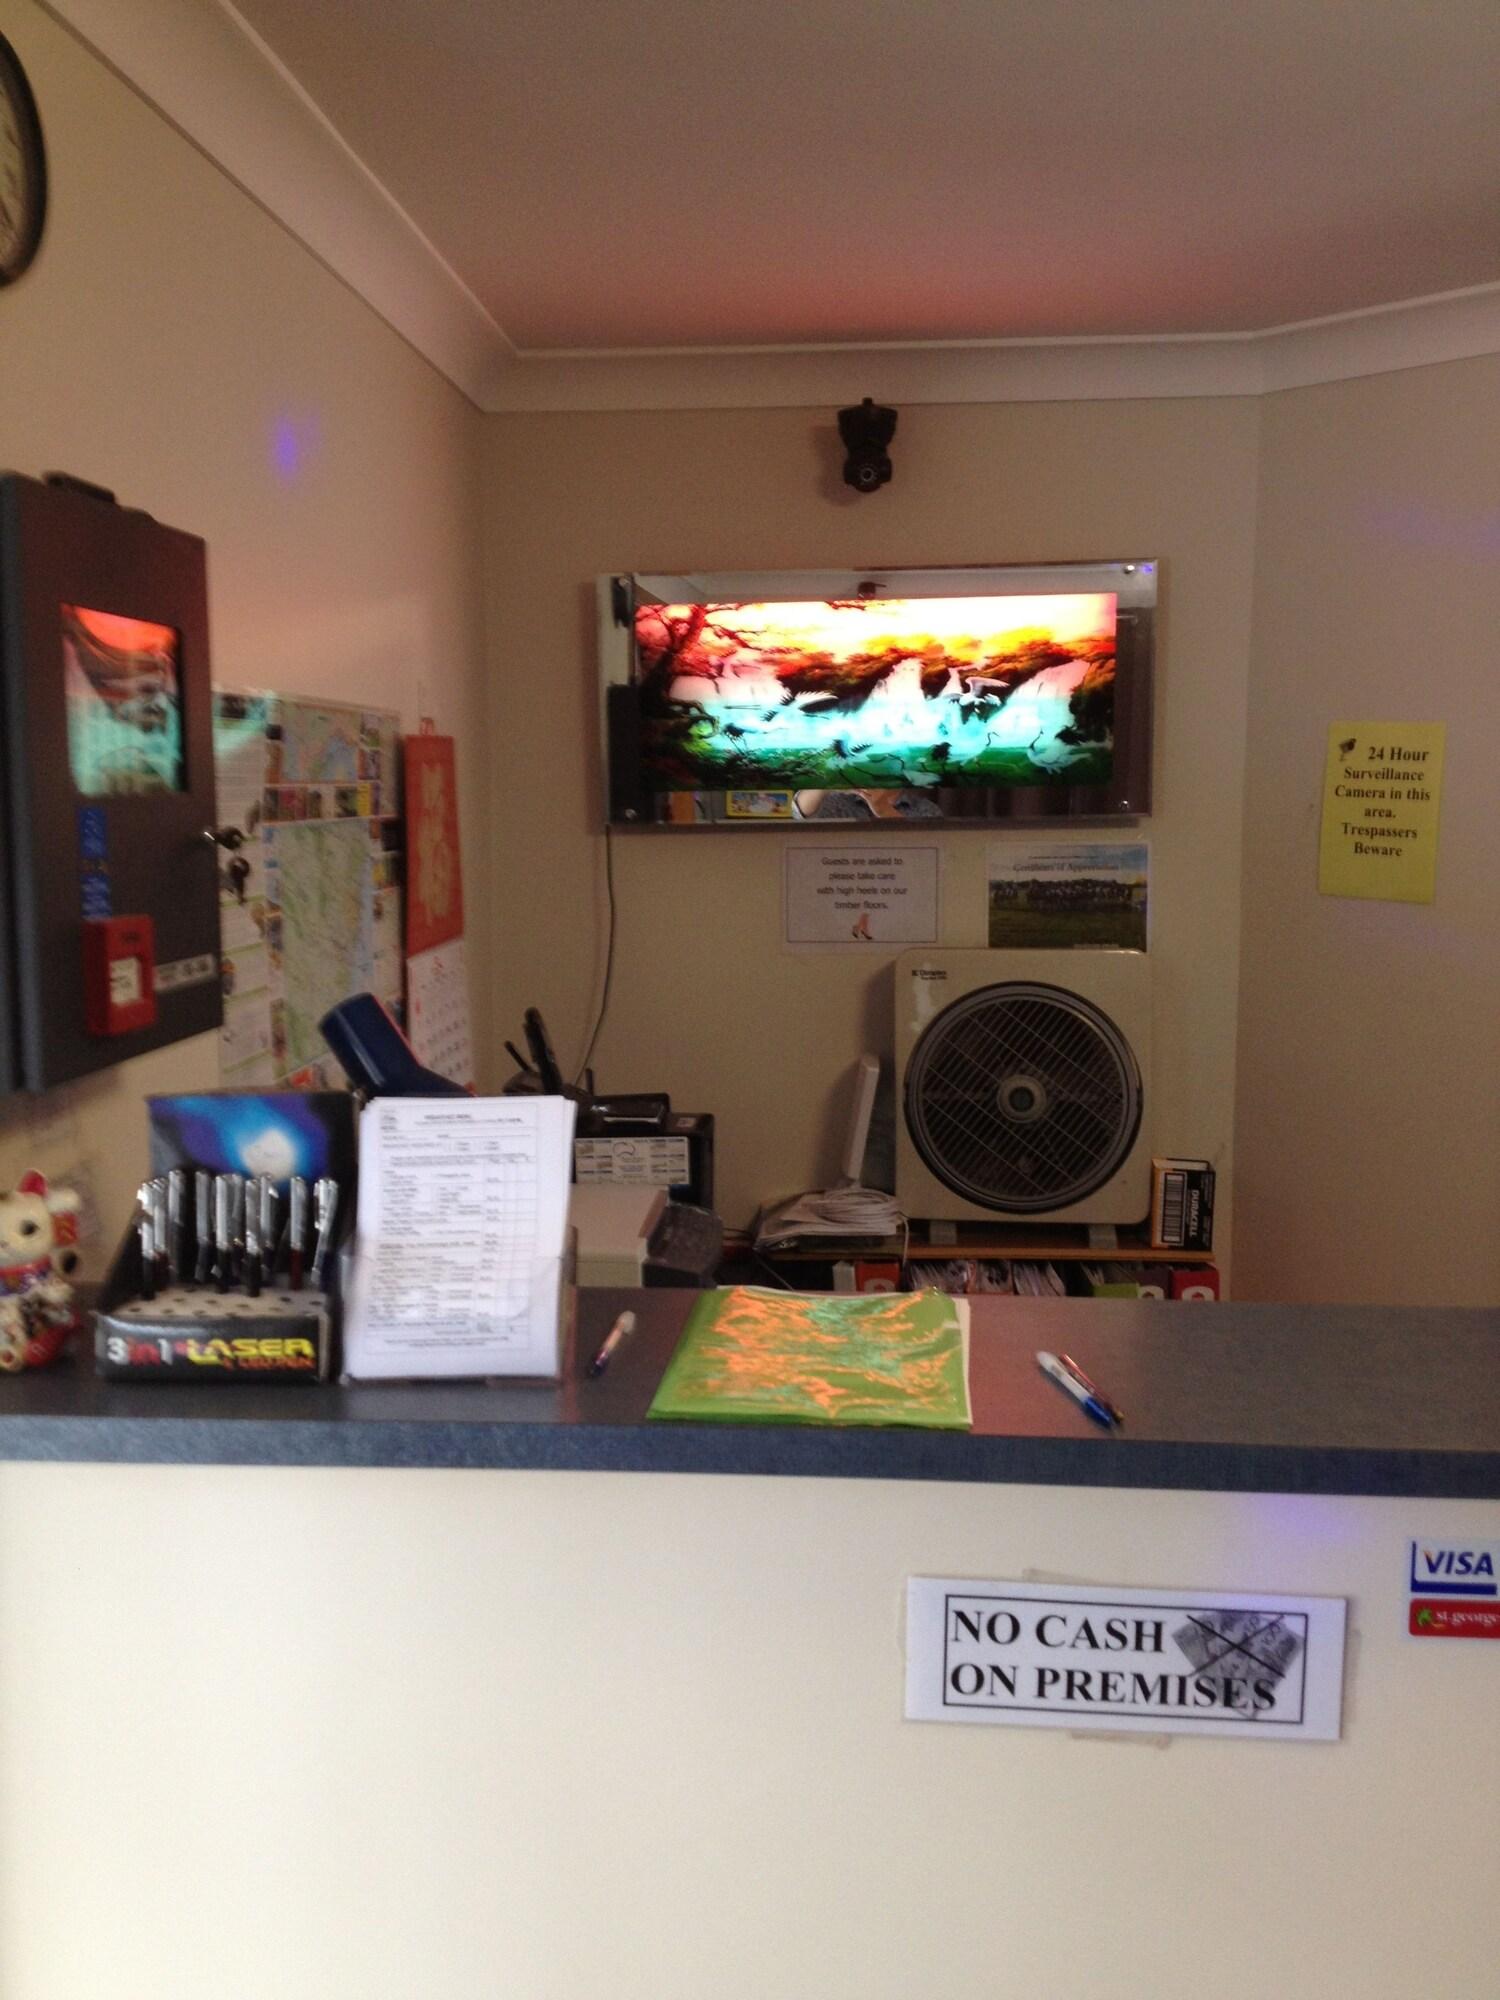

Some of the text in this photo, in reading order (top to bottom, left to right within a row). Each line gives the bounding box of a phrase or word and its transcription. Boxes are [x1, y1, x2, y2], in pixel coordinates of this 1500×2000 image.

[1368, 746, 1430, 762] 24 Hour
[1343, 766, 1425, 782] Surveillance
[1335, 784, 1432, 801] Camera in this
[1364, 807, 1397, 818] area.
[1341, 822, 1418, 840] Trespassers
[1353, 841, 1403, 857] Beware
[821, 856, 903, 866] Guests are asked to
[828, 871, 896, 881] please take care
[816, 886, 834, 895] with
[836, 886, 854, 897] high
[880, 887, 891, 895] on
[893, 887, 908, 895] our
[1190, 1189, 1200, 1238] DURACELL
[187, 1337, 315, 1366] LASER
[1423, 1550, 1495, 1576] VISA
[952, 1609, 1168, 1653] NO CASH
[950, 1663, 1278, 1710] ON PREMISES
